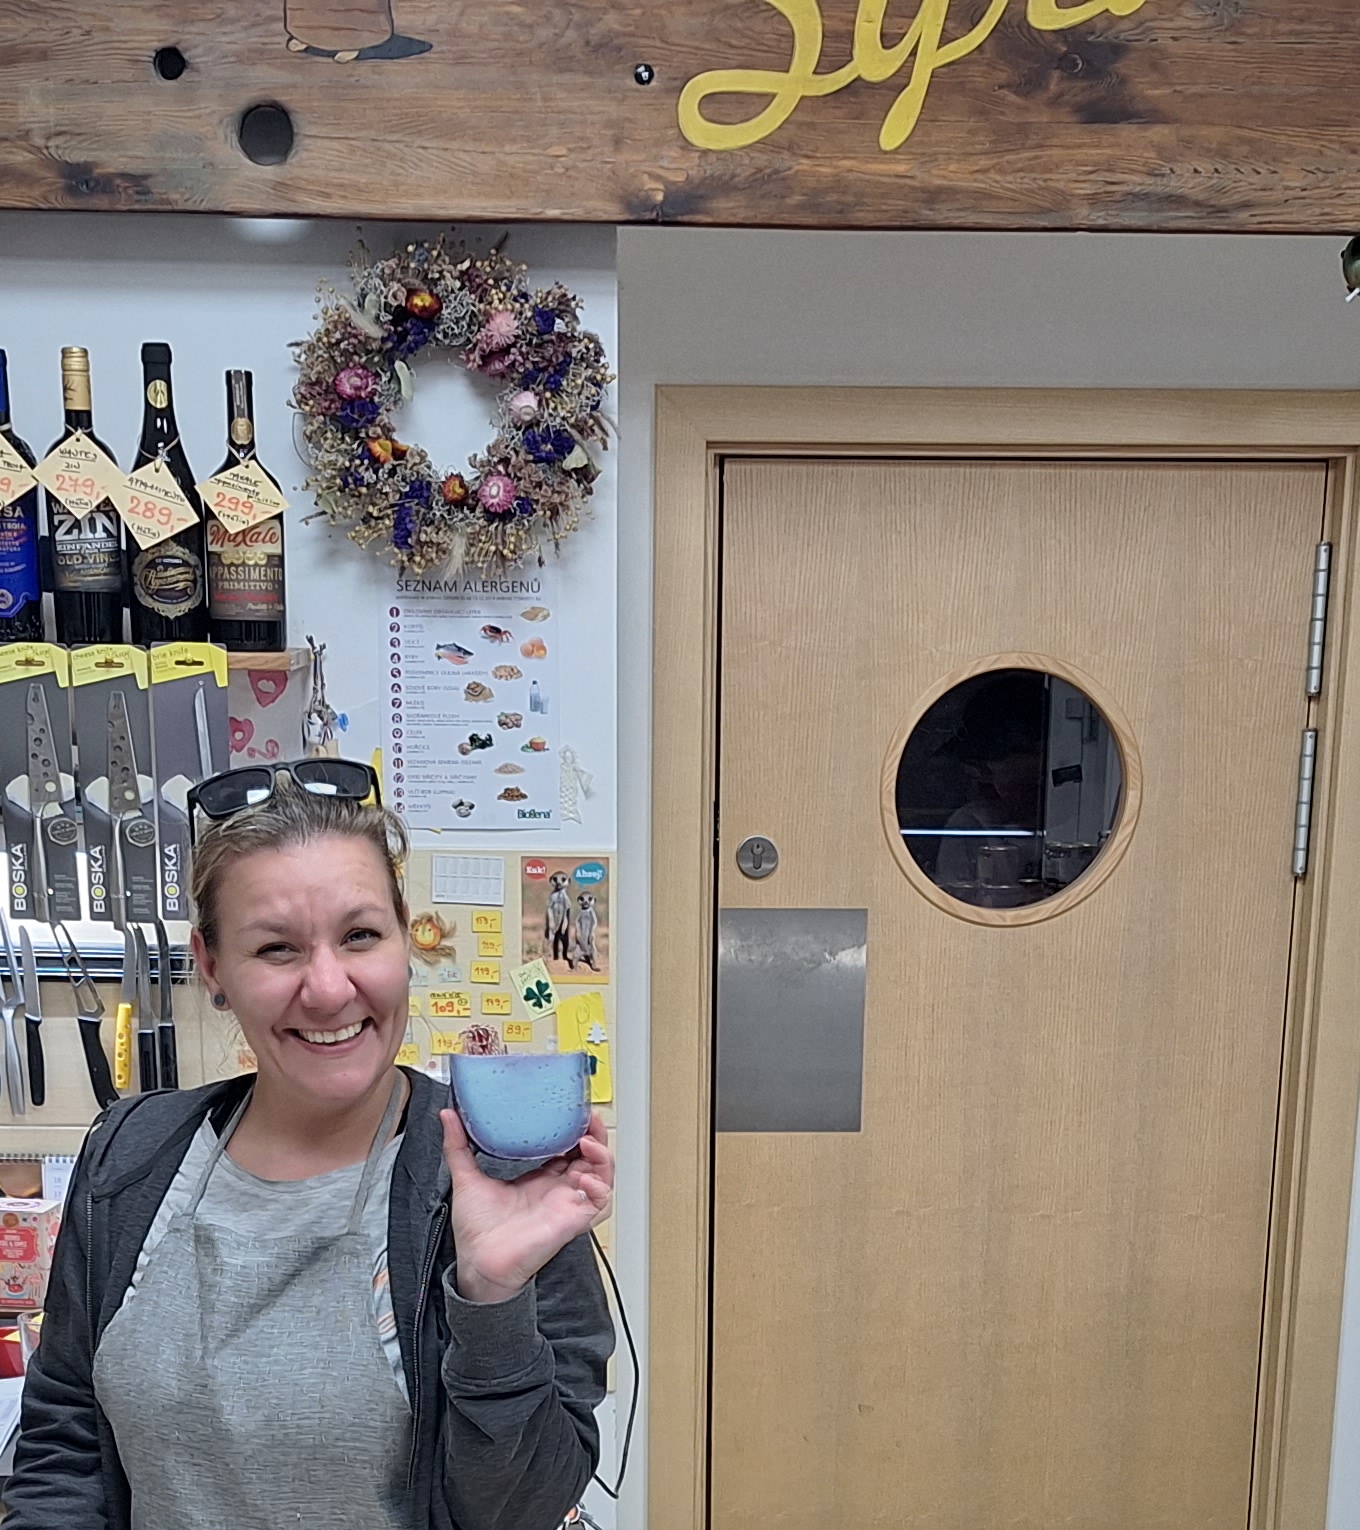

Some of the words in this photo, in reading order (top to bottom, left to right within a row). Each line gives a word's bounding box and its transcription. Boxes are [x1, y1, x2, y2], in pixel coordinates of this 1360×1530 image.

[54, 511, 120, 540] ZIN
[396, 579, 459, 593] SEZNAM
[463, 576, 541, 593] ALERGENŮ
[14, 843, 28, 912] BOSKA
[91, 845, 106, 914] BOSKA
[165, 844, 178, 913] BOSKA
